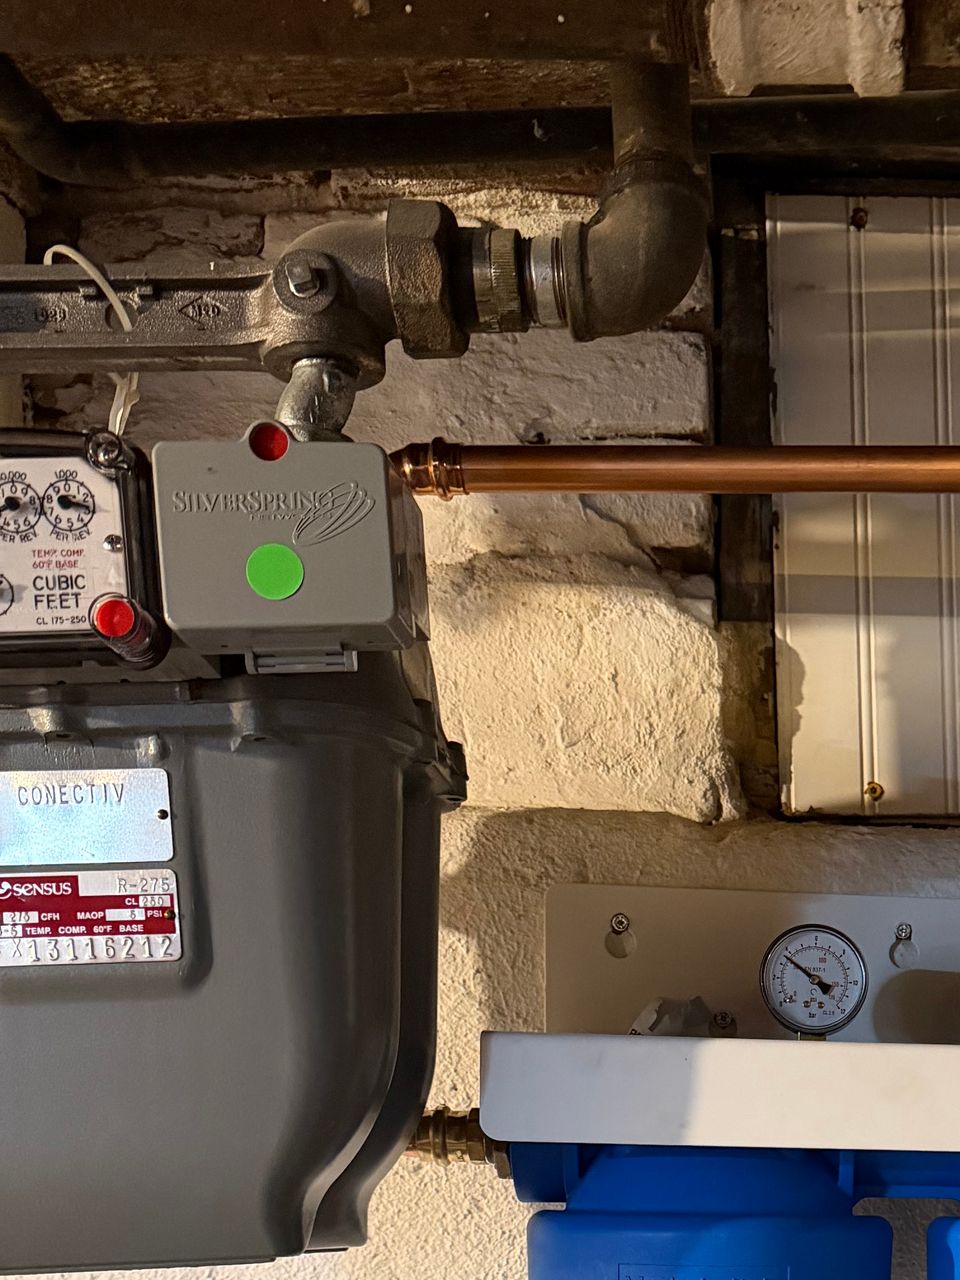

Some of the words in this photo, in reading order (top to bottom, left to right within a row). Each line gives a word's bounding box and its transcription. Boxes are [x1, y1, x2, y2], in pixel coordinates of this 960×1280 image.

[56, 560, 79, 568] BASE
[33, 574, 86, 591] CUBIC
[34, 592, 82, 610] FEET
[36, 616, 48, 625] CL
[51, 616, 86, 624] 175-250
[18, 783, 124, 806] CONECTIV
[117, 878, 170, 894] R-275
[125, 897, 138, 905] CL
[40, 912, 60, 921] CFH
[77, 912, 104, 920] MAOP
[147, 910, 163, 918] PSI
[26, 926, 51, 935] TEMP.
[58, 926, 87, 934] COMP.
[93, 925, 113, 933] 60°F
[119, 924, 144, 933] BASE
